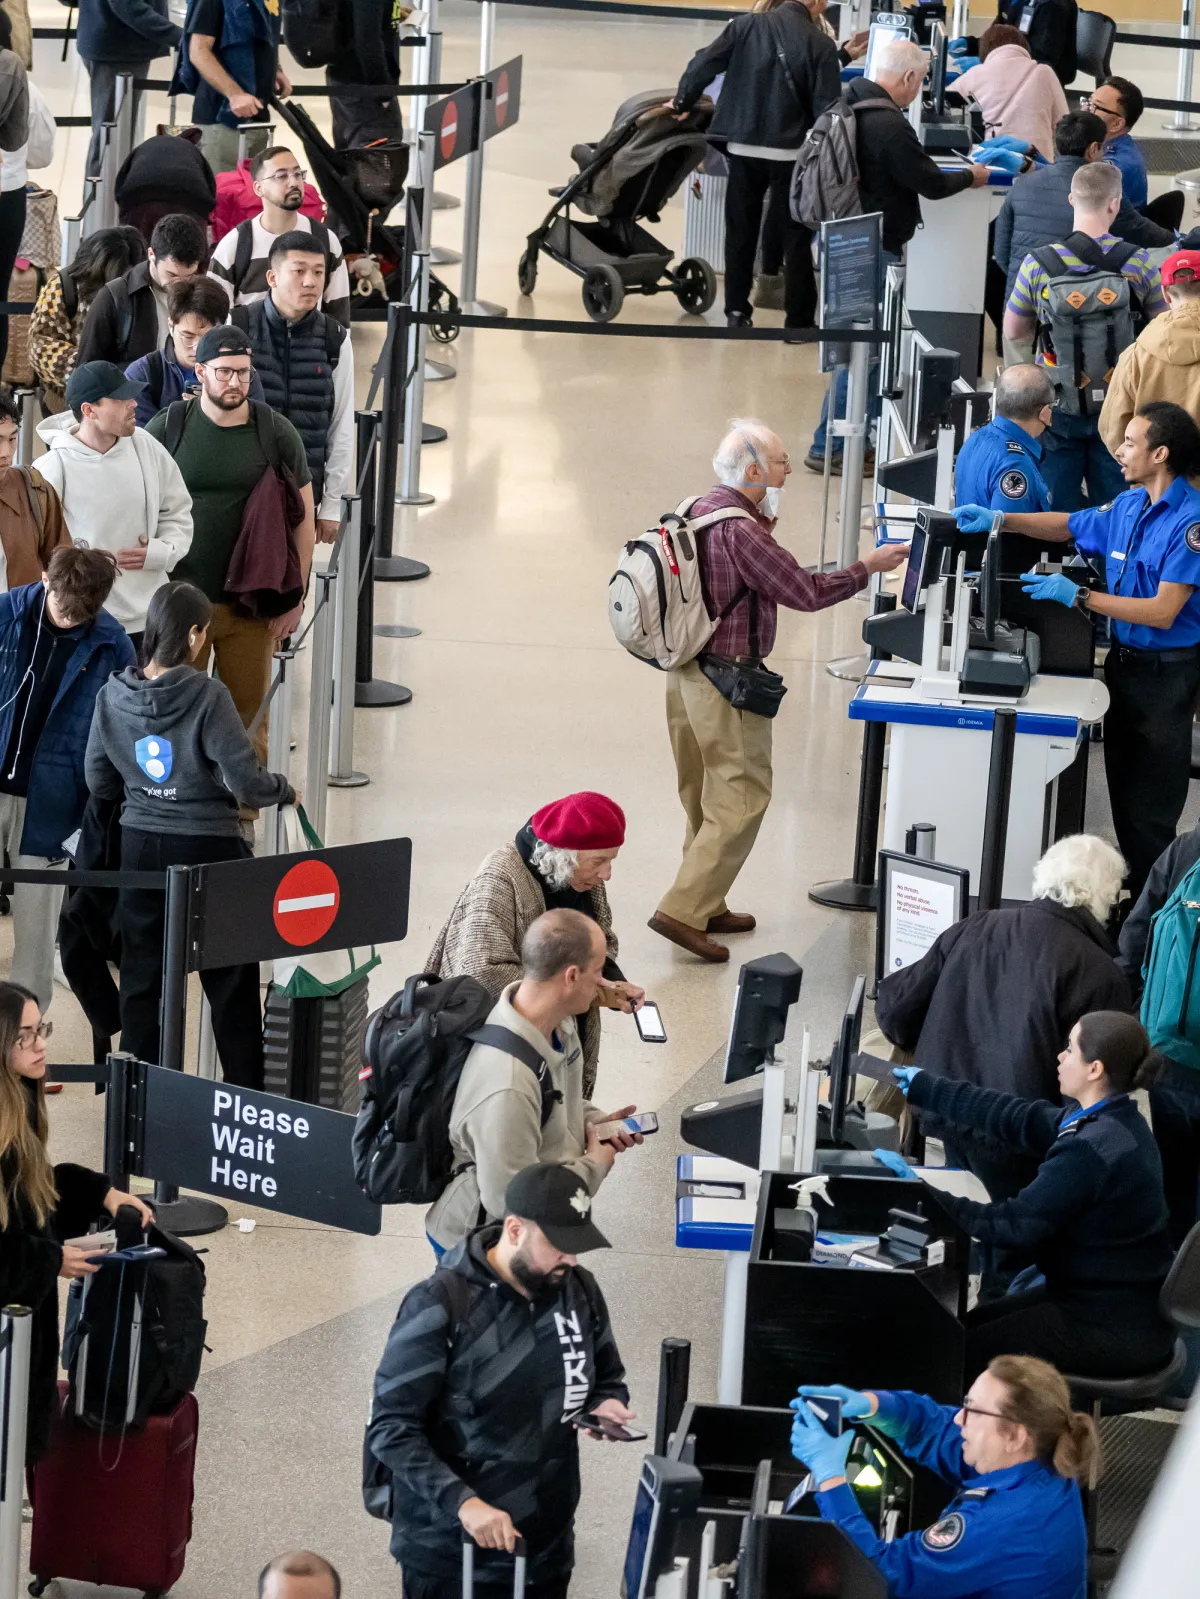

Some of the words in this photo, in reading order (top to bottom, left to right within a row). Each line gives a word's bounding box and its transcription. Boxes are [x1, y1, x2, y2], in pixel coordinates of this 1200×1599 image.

[163, 787, 177, 797] got
[903, 901, 921, 910] physical
[904, 894, 918, 902] verbal
[213, 1089, 310, 1139] Please
[211, 1122, 276, 1165] Wait
[210, 1156, 278, 1198] Here
[815, 1250, 848, 1259] DIAMOND
[553, 1309, 589, 1410] NIKE
